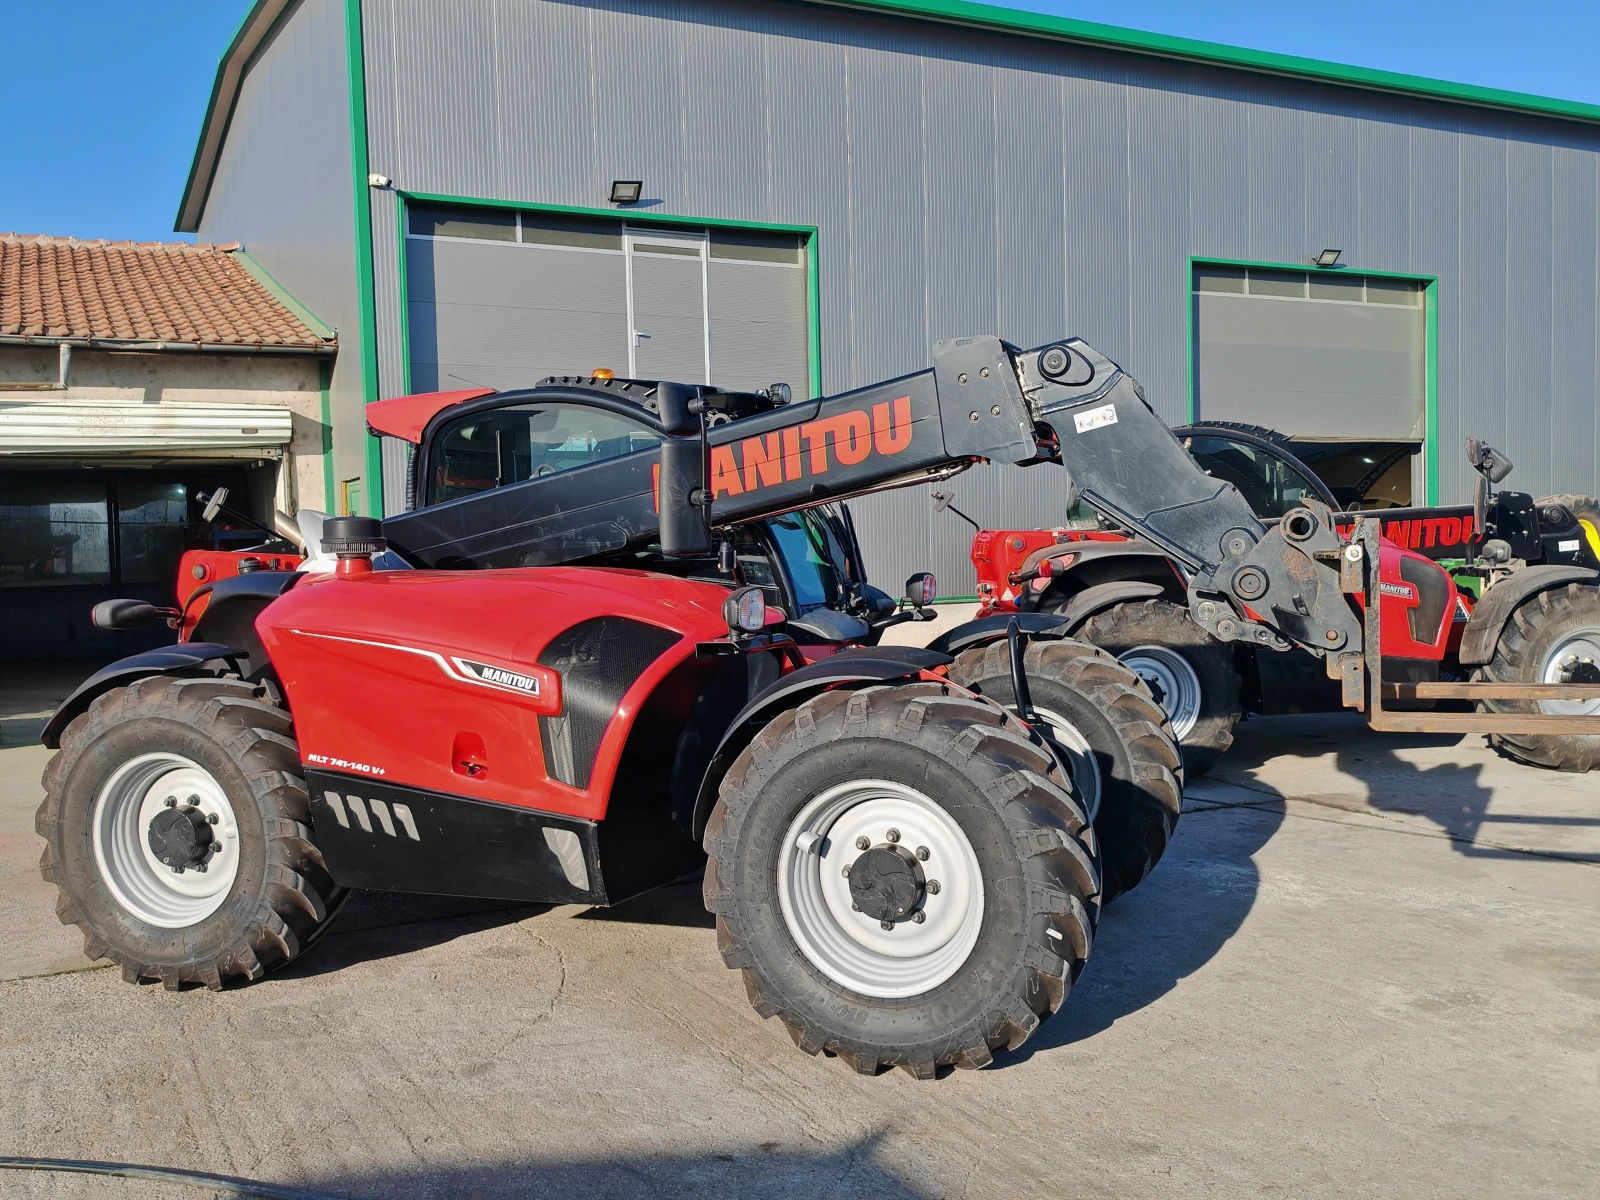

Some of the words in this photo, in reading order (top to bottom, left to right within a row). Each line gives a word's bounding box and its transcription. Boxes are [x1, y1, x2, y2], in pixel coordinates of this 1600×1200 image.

[652, 395, 912, 515] ANITOU
[1336, 516, 1483, 550] NITOU
[482, 667, 534, 690] MANITOU
[307, 753, 329, 764] MLT
[329, 757, 371, 773] 741-140
[371, 766, 386, 776] V+
